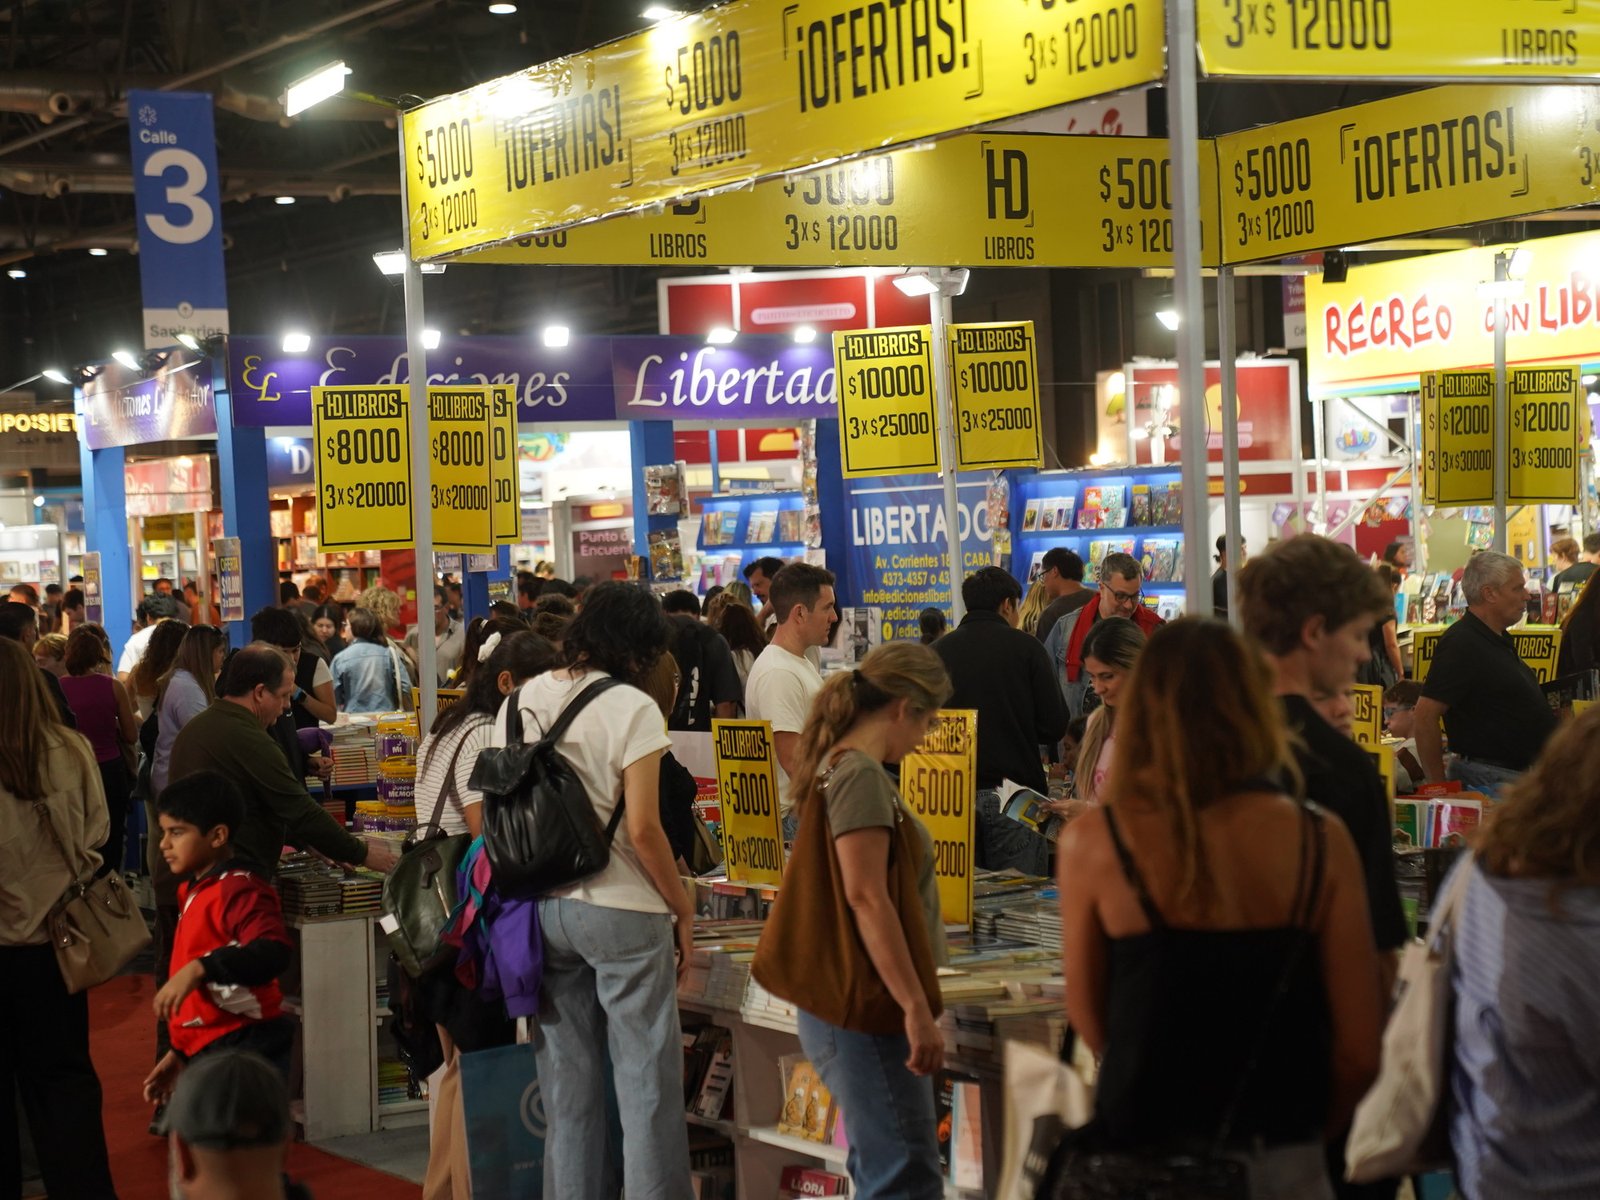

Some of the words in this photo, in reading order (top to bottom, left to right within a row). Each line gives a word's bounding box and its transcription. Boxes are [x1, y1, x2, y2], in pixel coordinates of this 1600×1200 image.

[1502, 28, 1578, 67] LIBROS
[140, 130, 178, 144] Calle
[1353, 106, 1516, 204] ¡OFERTAS!
[143, 148, 214, 245] 3
[985, 149, 1029, 220] HD
[650, 233, 707, 259] LIBROS
[984, 236, 1035, 260] LIBROS
[1325, 294, 1453, 356] RECREO
[866, 333, 919, 357] LIBROS
[976, 330, 1023, 351] LIBROS
[1456, 375, 1489, 395] LIBROS
[1530, 371, 1570, 392] LIBROS
[344, 392, 398, 417] LIBROS
[445, 395, 483, 419] LIBROS
[579, 531, 618, 544] Punto
[875, 555, 890, 569] Av.
[891, 553, 938, 569] Corrientes
[964, 551, 992, 567] CABA
[883, 571, 928, 586] 4373-4357
[732, 730, 766, 759] LIBROS
